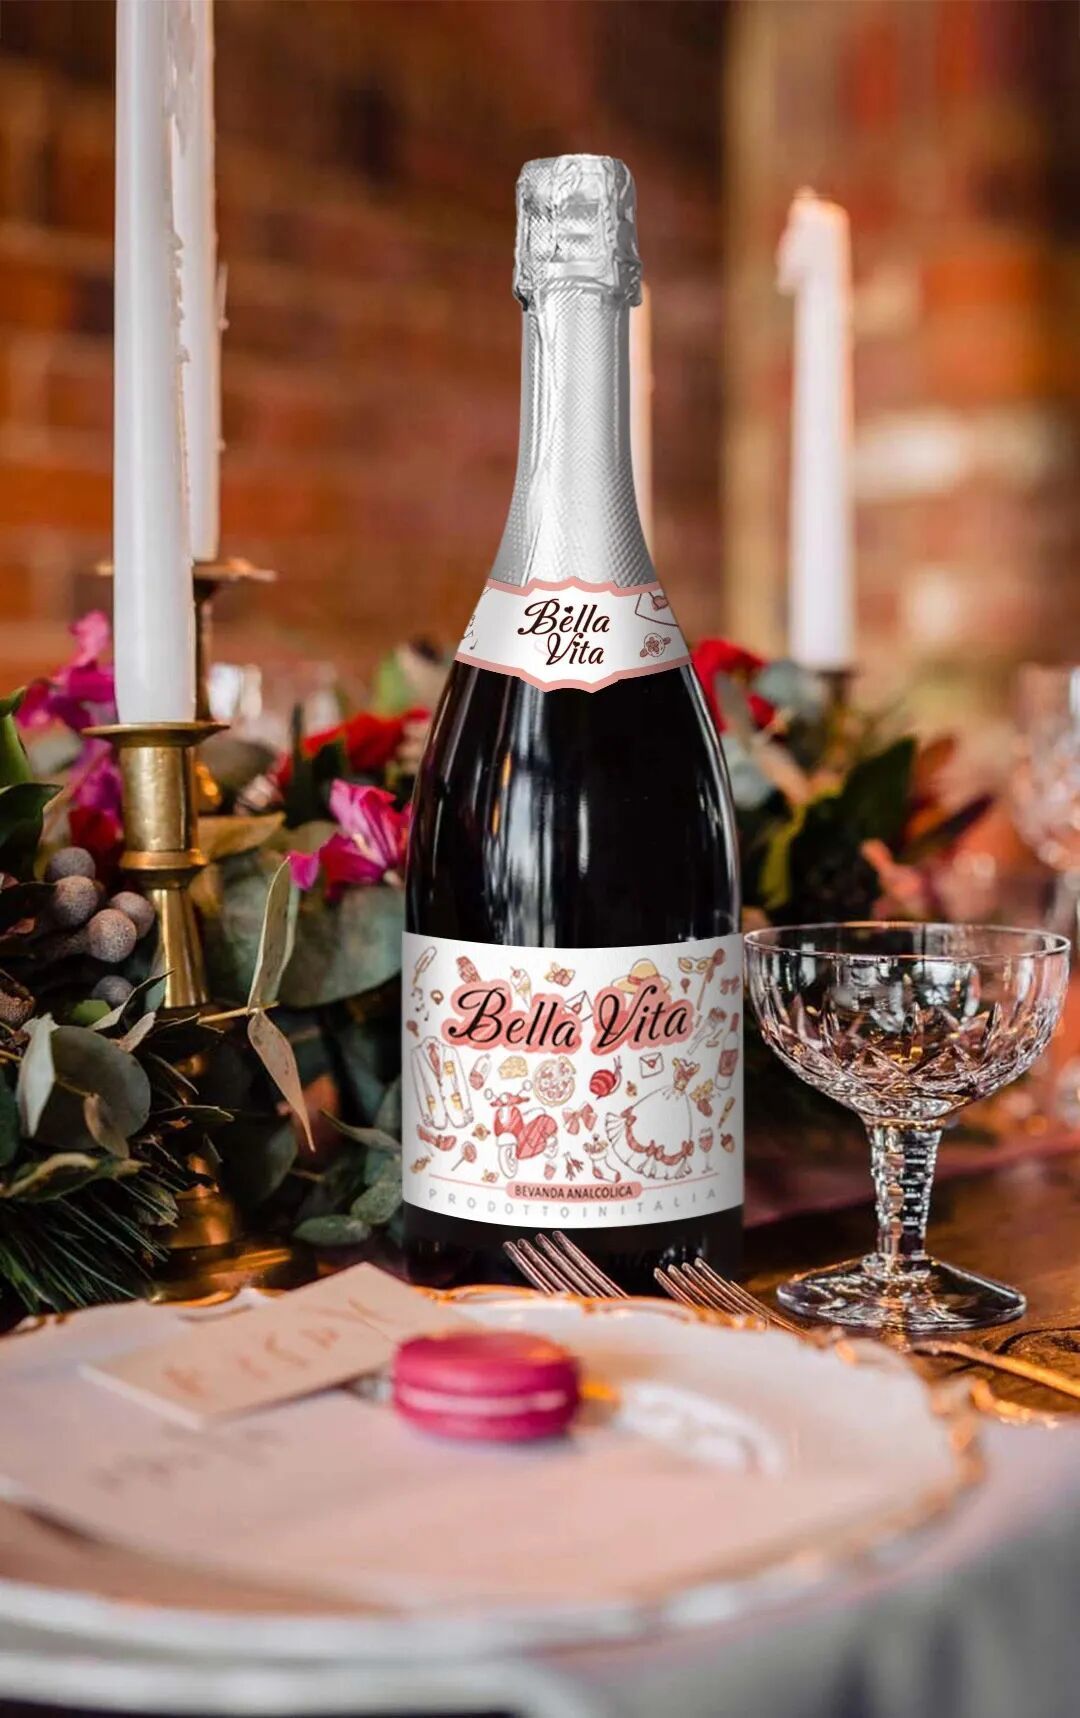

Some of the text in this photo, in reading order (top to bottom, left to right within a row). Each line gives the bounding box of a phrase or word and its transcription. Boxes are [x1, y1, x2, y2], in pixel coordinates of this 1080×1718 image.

[517, 598, 610, 636] Bella
[546, 632, 605, 666] Vita
[448, 984, 689, 1050] Bella Vita
[514, 1184, 634, 1200] BEVANDA ANALCOLICA
